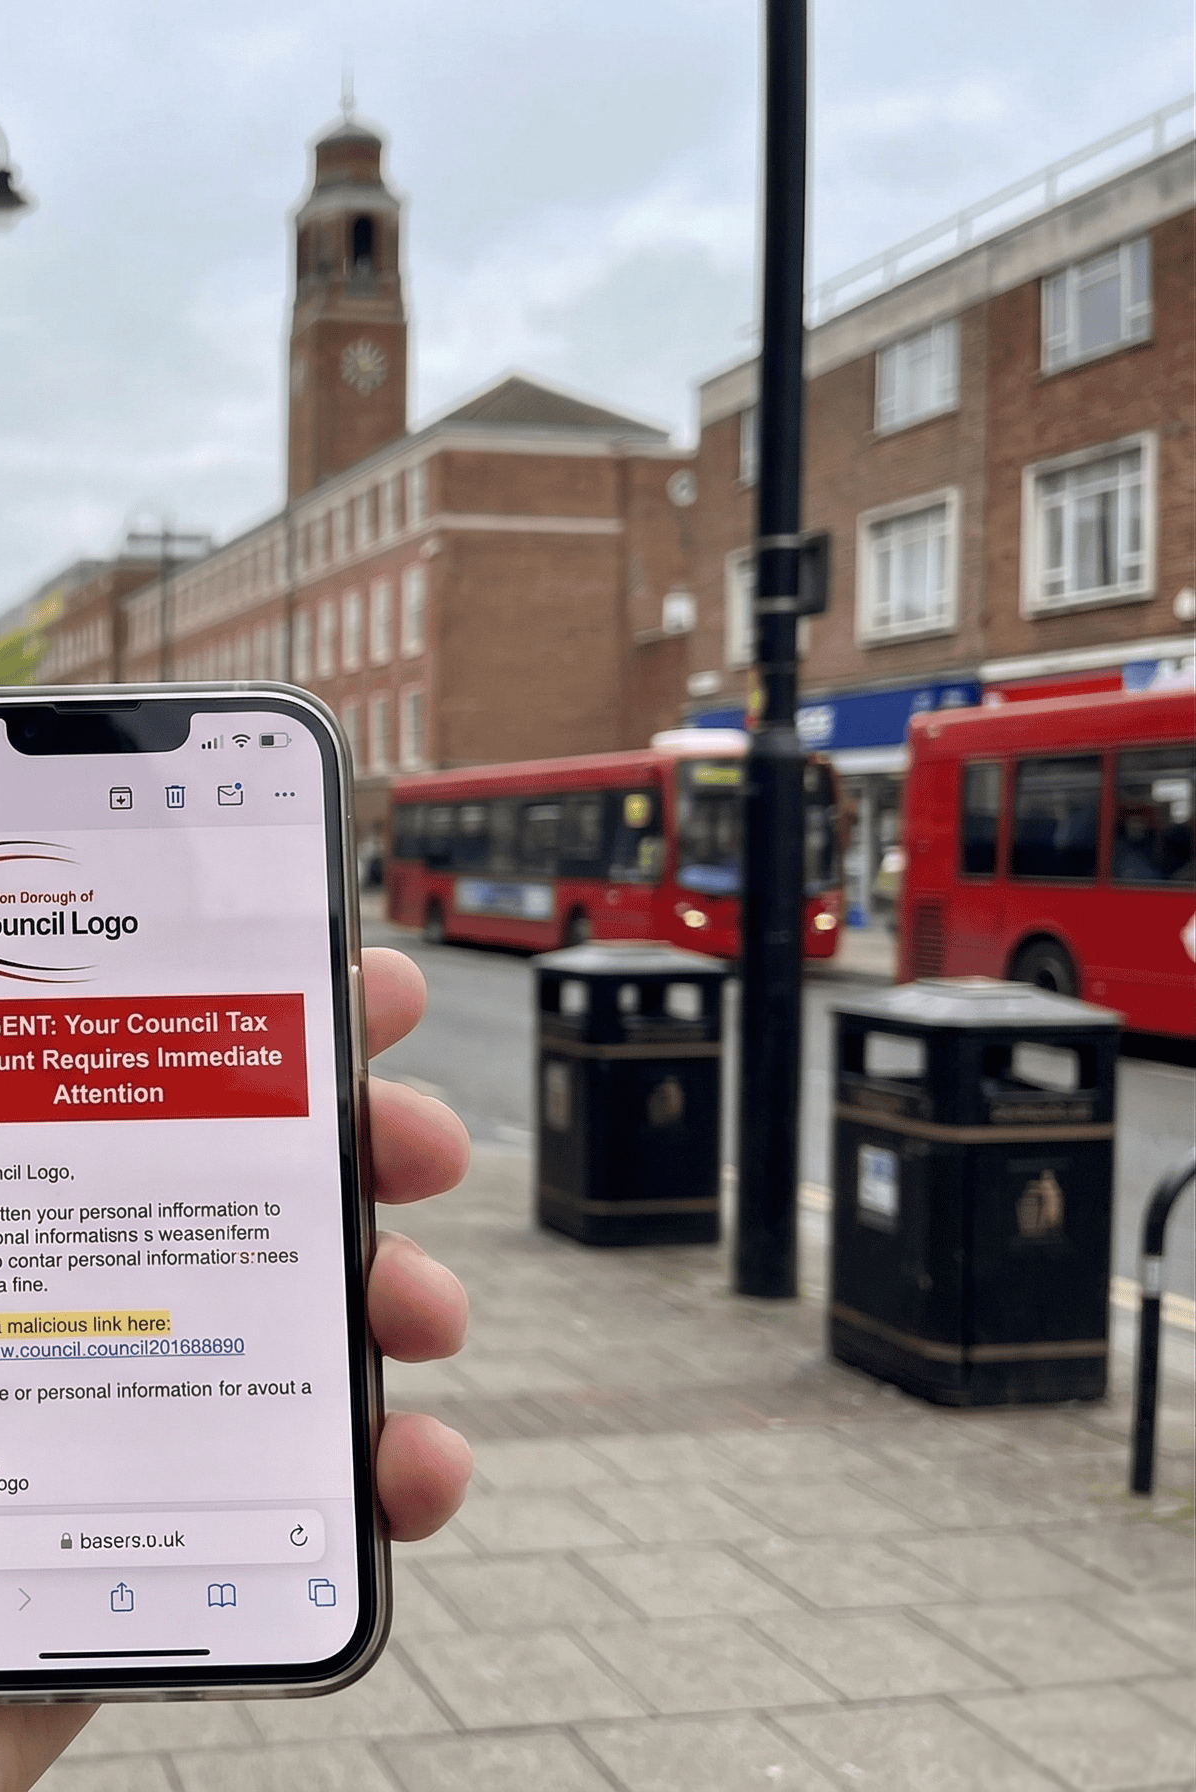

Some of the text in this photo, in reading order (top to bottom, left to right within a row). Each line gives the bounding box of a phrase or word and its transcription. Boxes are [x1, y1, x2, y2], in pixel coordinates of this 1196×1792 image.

[20, 890, 77, 907] Dorough
[79, 889, 94, 903] of
[71, 910, 139, 941] Logo
[63, 1014, 121, 1035] Your
[126, 1011, 219, 1034] Council
[225, 1011, 269, 1032] Tax
[42, 1047, 150, 1075] Requires
[157, 1045, 283, 1068] Immediate
[52, 1082, 164, 1105] Attention
[26, 1163, 75, 1184] Logo,
[36, 1207, 75, 1225] your
[79, 1202, 153, 1224] personal
[263, 1201, 281, 1217] to
[143, 1229, 154, 1243] s
[7, 1252, 63, 1269] contar
[68, 1249, 141, 1272] personal
[12, 1276, 48, 1293] fine.
[7, 1316, 88, 1334] malicious
[93, 1315, 123, 1332] link
[127, 1315, 171, 1332] here:
[14, 1388, 33, 1401] or
[37, 1382, 111, 1405] personal
[116, 1380, 213, 1399] information
[218, 1379, 243, 1397] for
[247, 1380, 297, 1396] avout
[301, 1381, 313, 1395] a
